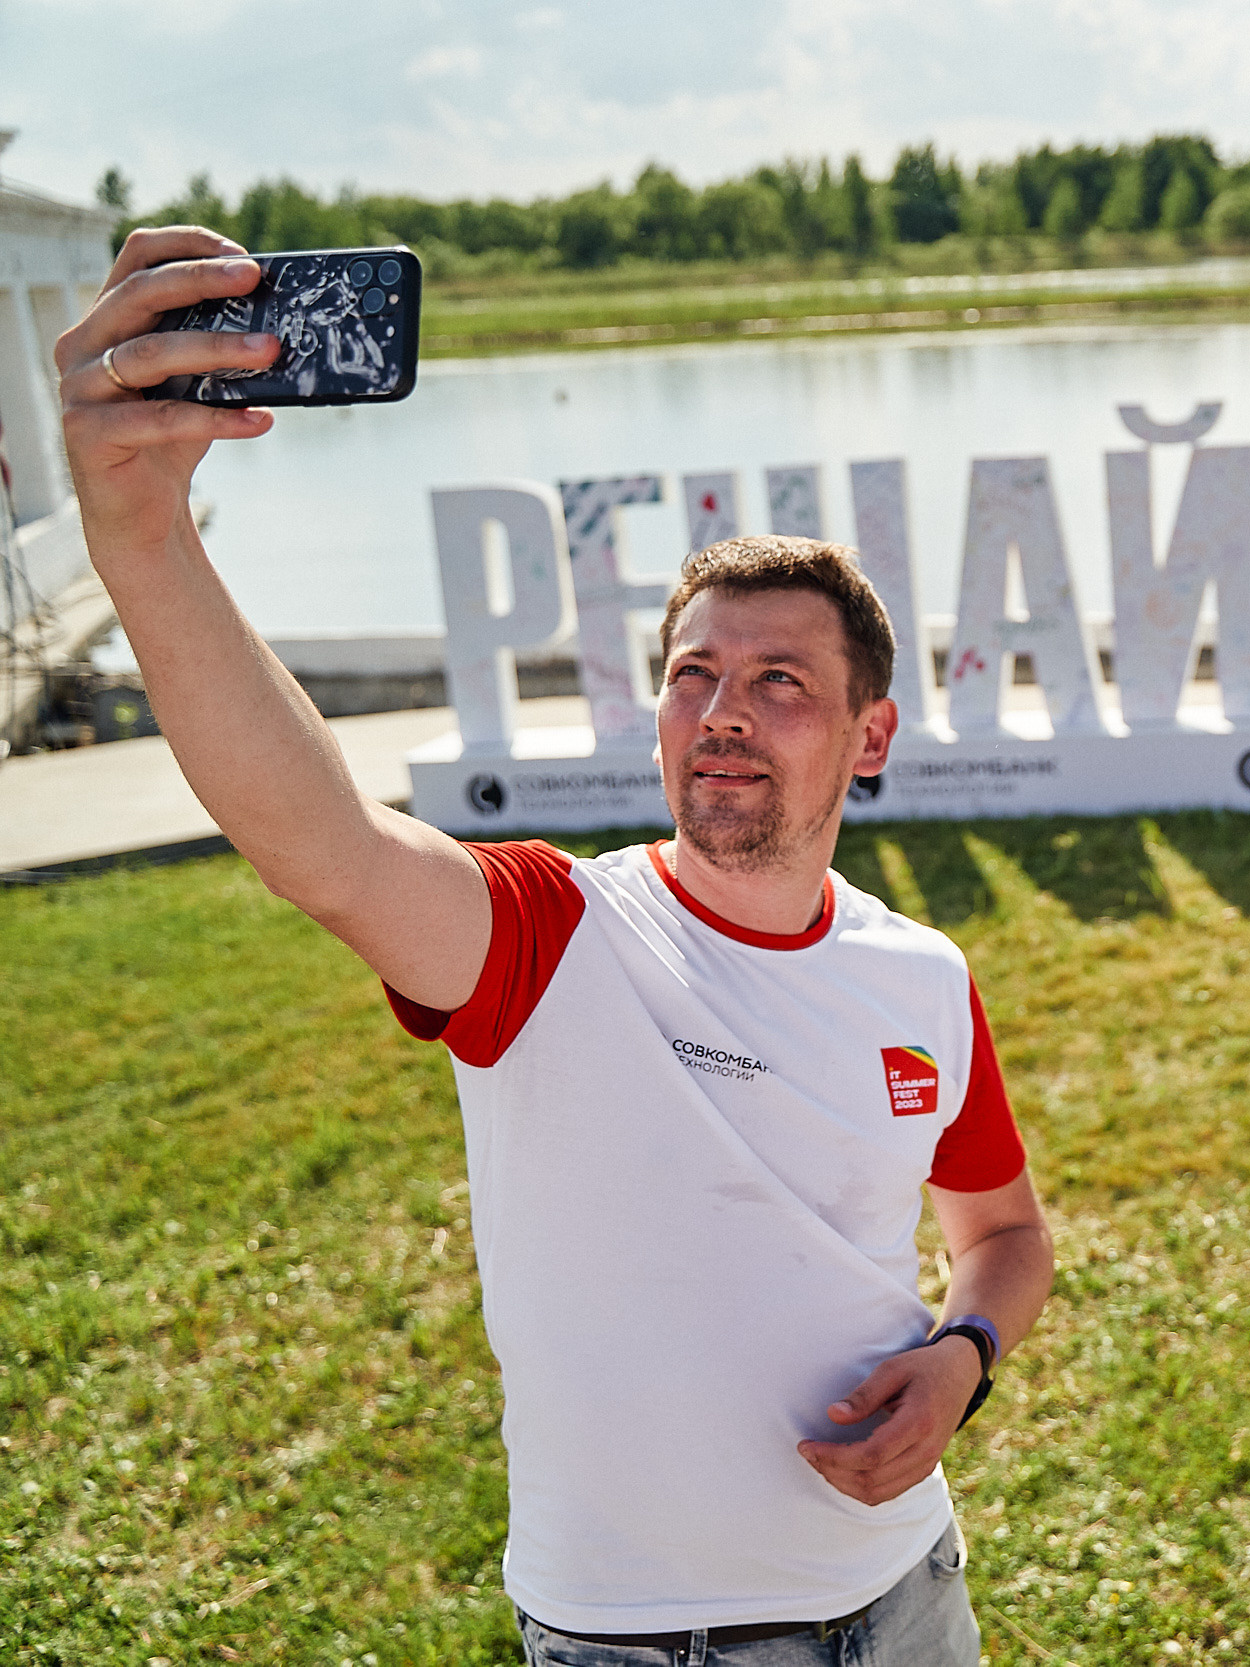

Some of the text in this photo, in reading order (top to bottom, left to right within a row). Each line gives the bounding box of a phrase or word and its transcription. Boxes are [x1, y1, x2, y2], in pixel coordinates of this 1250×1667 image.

[672, 1039, 773, 1074] СОВКОМБА
[676, 1053, 755, 1082] ЕХНОЛОГИИ
[891, 1078, 936, 1090] SUMMER
[893, 1089, 919, 1099] FEST
[895, 1099, 923, 1109] 2023
